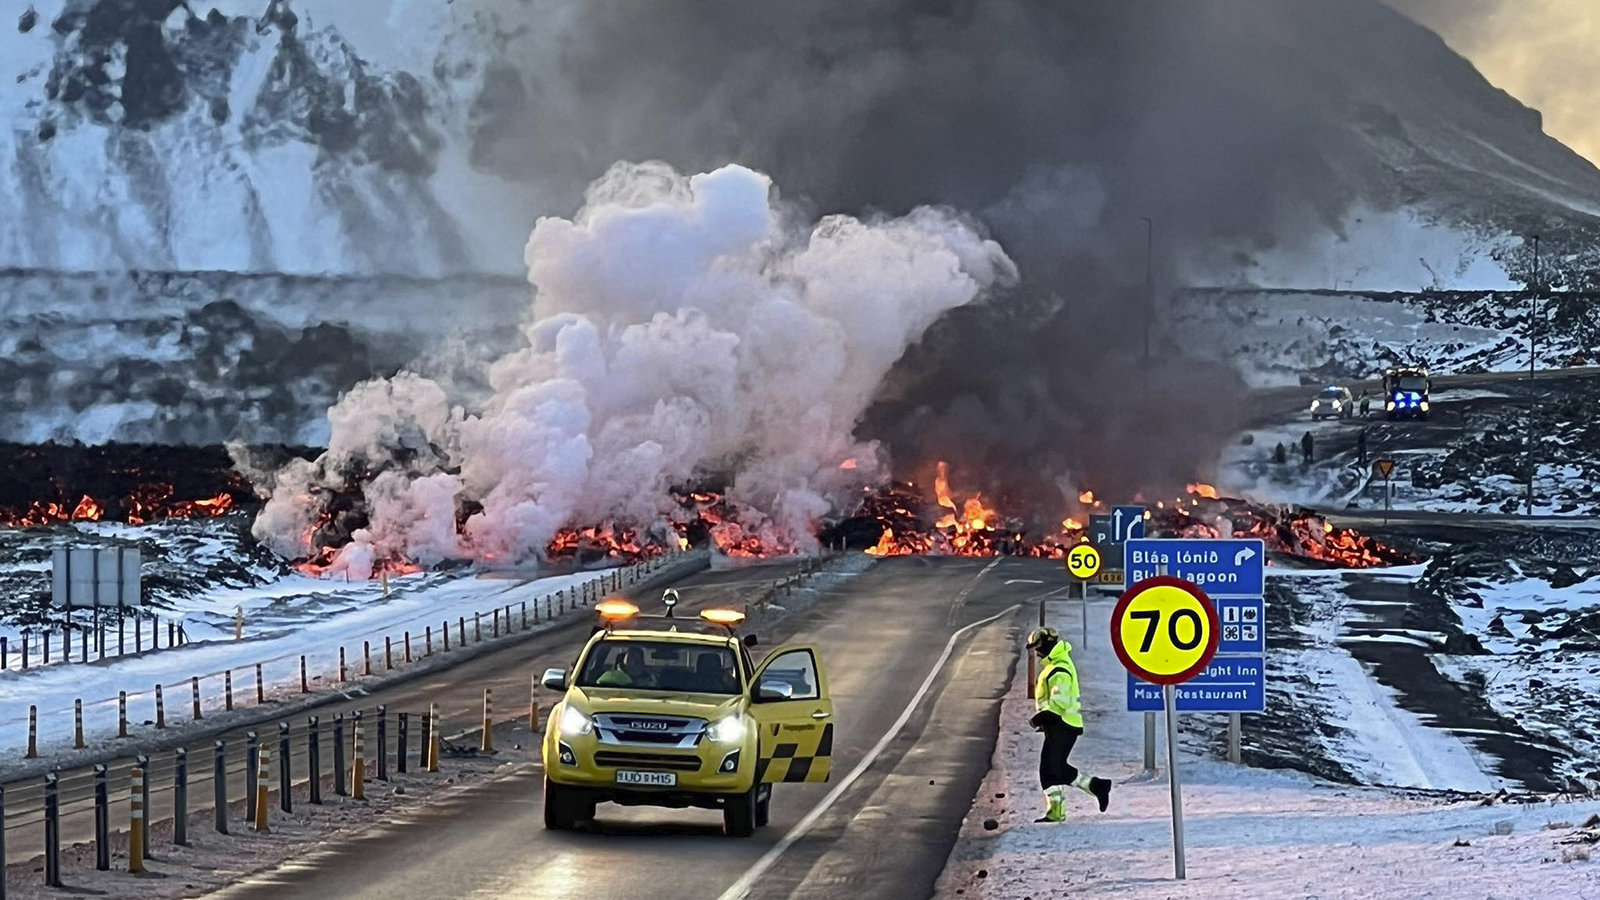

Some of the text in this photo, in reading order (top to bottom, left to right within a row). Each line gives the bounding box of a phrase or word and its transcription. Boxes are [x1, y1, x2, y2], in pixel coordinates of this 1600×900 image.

[1071, 553, 1097, 569] 50
[1133, 550, 1218, 563] Bláa lónið
[1130, 608, 1203, 653] 70
[1237, 665, 1257, 676] Inn
[1135, 688, 1247, 699] Max Restaurant
[631, 721, 667, 730] ISUZU
